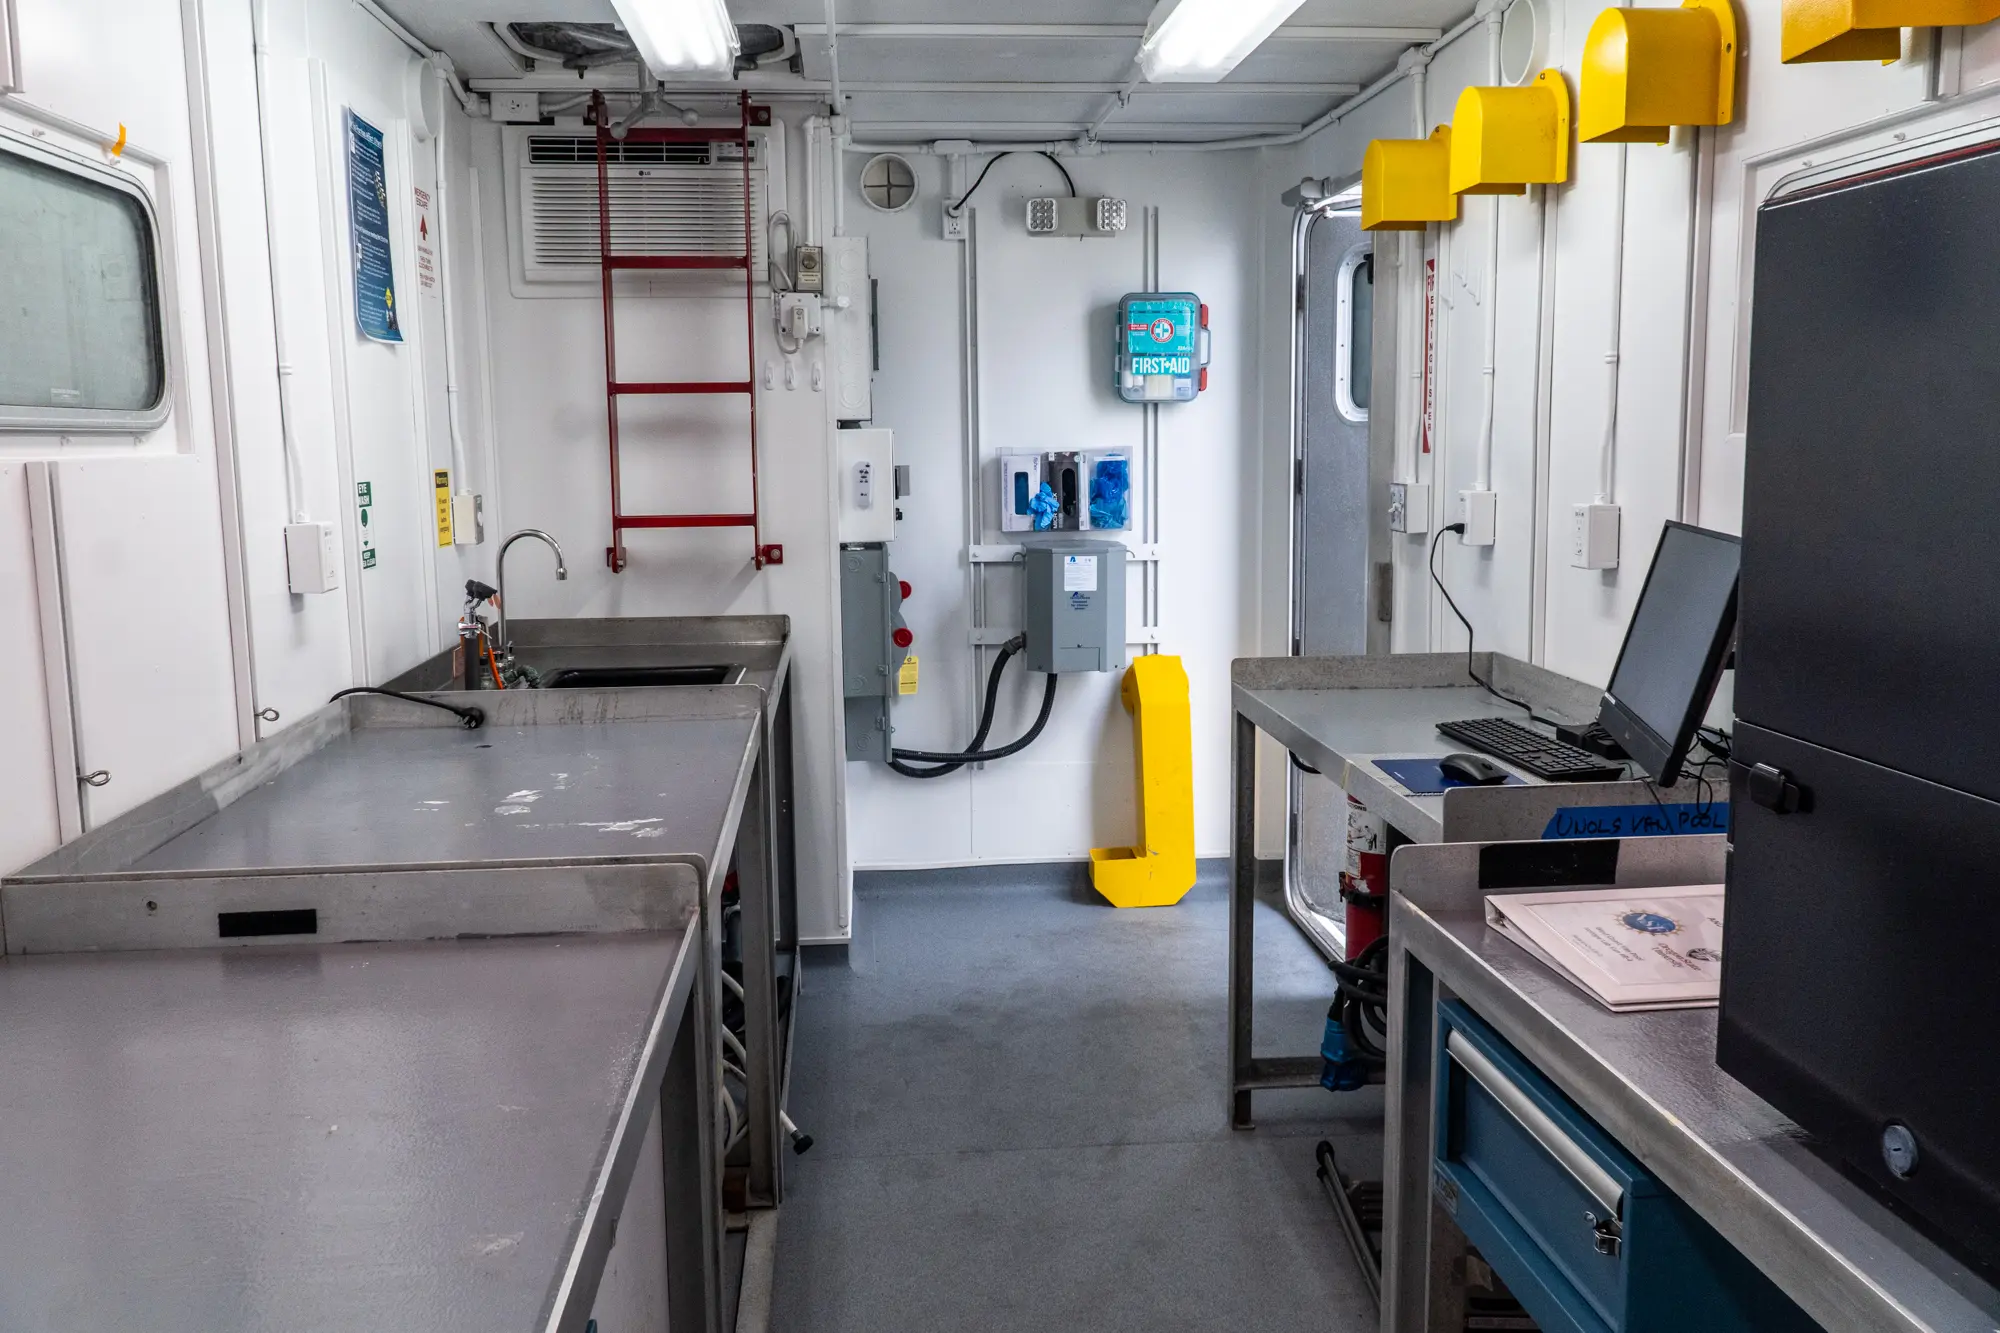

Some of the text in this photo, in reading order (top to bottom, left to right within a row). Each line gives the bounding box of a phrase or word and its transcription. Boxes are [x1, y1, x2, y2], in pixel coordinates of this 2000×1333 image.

[358, 483, 368, 494] EYE
[1556, 812, 1726, 836] UNOLS VAN POOL
